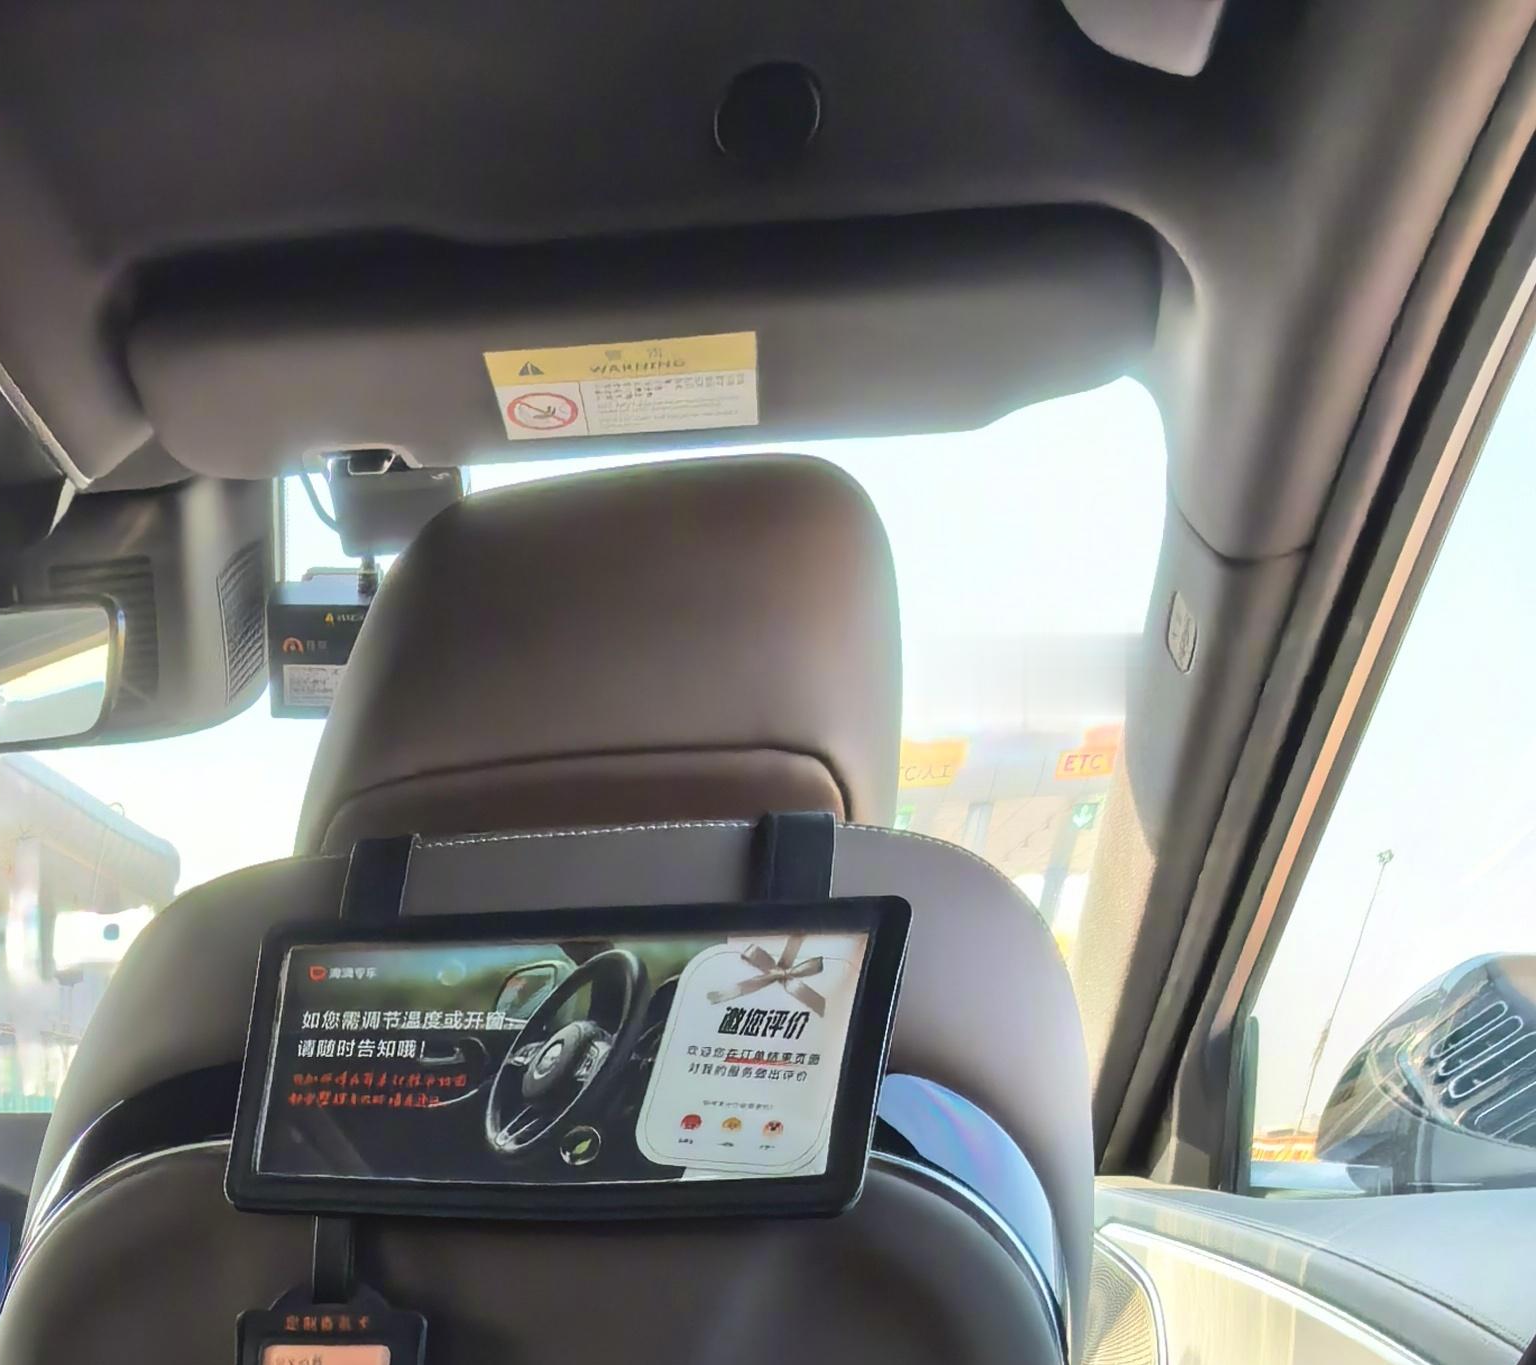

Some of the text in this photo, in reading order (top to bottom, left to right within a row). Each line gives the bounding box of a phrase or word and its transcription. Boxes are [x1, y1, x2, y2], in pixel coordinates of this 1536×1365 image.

[1063, 753, 1104, 773] ETC
[717, 1006, 811, 1040] 邀您评价
